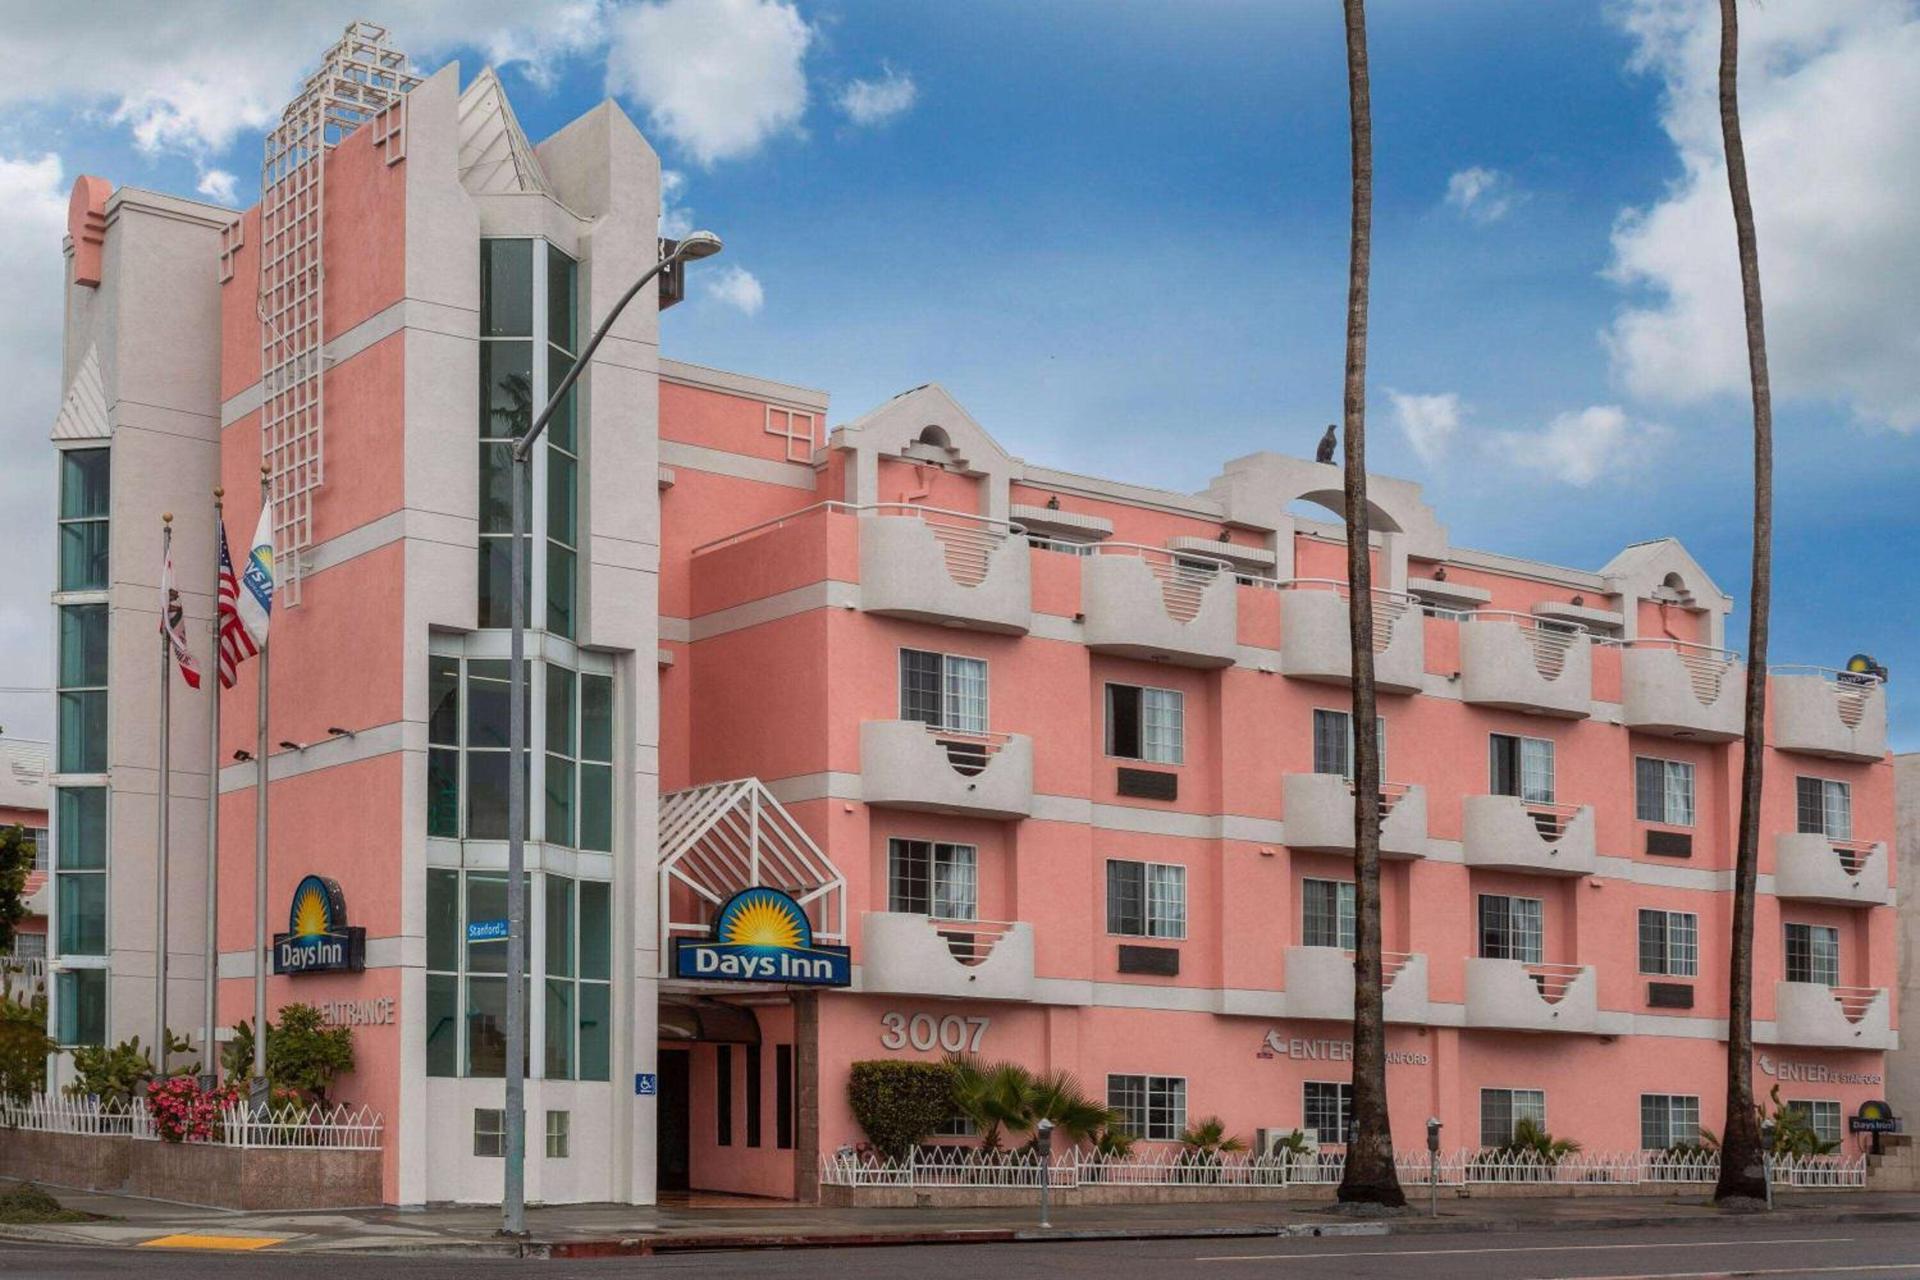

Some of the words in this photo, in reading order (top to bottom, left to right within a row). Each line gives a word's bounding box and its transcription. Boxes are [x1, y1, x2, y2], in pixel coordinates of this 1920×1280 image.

[469, 922, 500, 937] Stanford
[282, 944, 315, 969] Days
[318, 941, 342, 964] Inn
[696, 949, 774, 978] Days
[781, 954, 833, 979] Inn
[323, 996, 395, 1025] ENTRANCE
[881, 1012, 990, 1053] 3007
[1290, 1039, 1353, 1061] ENTER
[1777, 1062, 1828, 1082] ENTER
